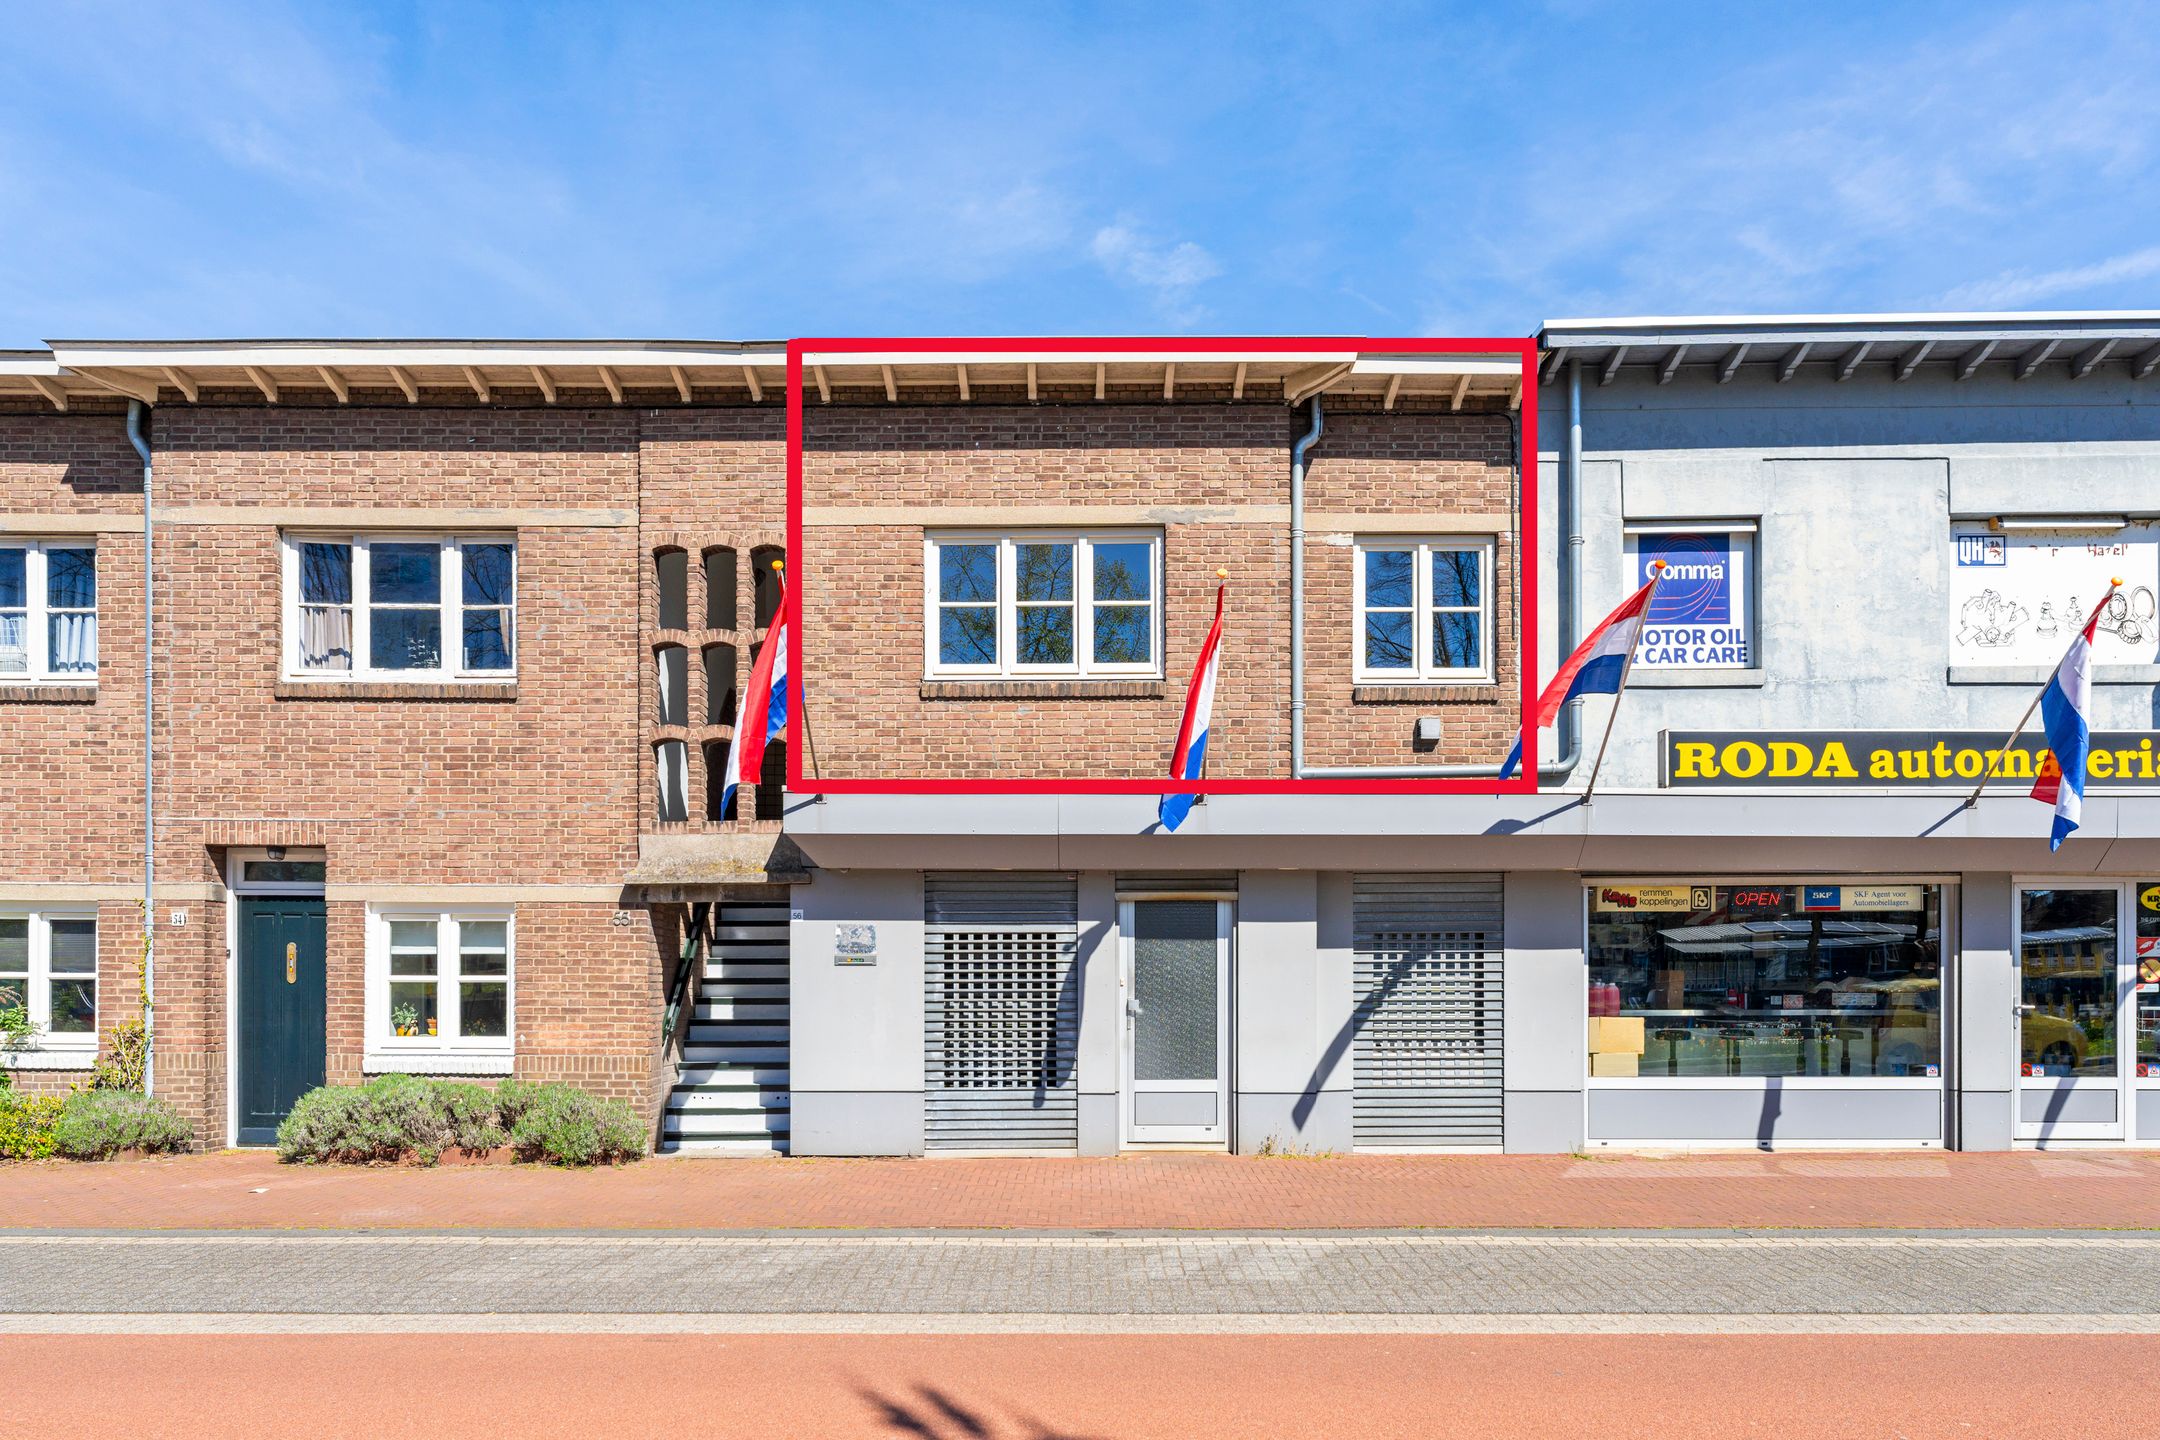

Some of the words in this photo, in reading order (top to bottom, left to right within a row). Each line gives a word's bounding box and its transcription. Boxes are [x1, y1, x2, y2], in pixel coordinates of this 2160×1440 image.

[1959, 536, 1984, 565] QH
[1645, 560, 1725, 580] Comma
[1710, 628, 1746, 645] OIL
[1644, 647, 1688, 664] CAR
[1693, 647, 1748, 664] CARE
[1674, 741, 1859, 778] RODA
[1869, 738, 2160, 779] automaeri
[1639, 889, 1673, 897] remmen
[1735, 892, 1782, 906] OPEN
[1871, 891, 1891, 900] Agent
[1639, 896, 1688, 907] koppelingen
[1852, 899, 1909, 908] Automobiellagers
[173, 914, 182, 925] 54
[613, 911, 629, 927] 55
[792, 912, 802, 920] 56
